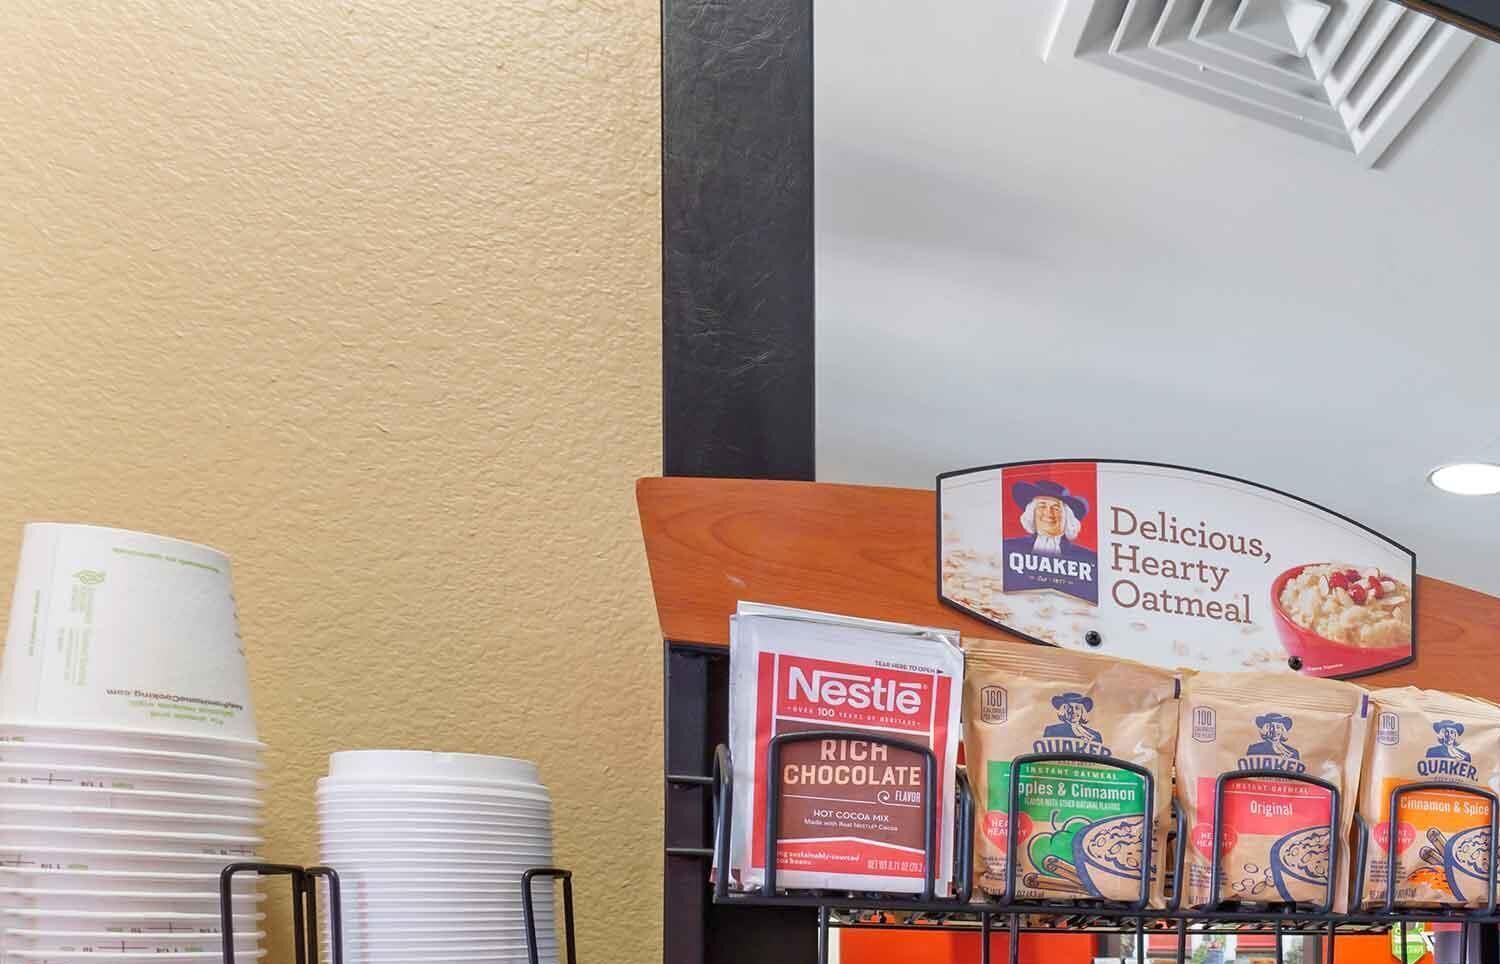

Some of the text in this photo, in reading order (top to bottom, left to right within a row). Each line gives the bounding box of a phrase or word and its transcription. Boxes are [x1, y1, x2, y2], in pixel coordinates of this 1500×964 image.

[1110, 505, 1271, 564] Delicious,
[1009, 552, 1093, 581] QUAKER
[1111, 542, 1229, 592] Hearty
[1112, 579, 1252, 624] Oatmeal
[818, 708, 835, 717] 100
[821, 739, 887, 761] RICH
[784, 764, 921, 785] CHOCOLATE
[1417, 760, 1478, 782] QUAKER
[895, 790, 921, 803] FLAVOR
[1018, 781, 1136, 801] pples & Cinnamon
[814, 809, 889, 822] HOT COCOA MIX
[1250, 800, 1293, 817] Original
[1400, 796, 1490, 817] Cinnamon & Spice
